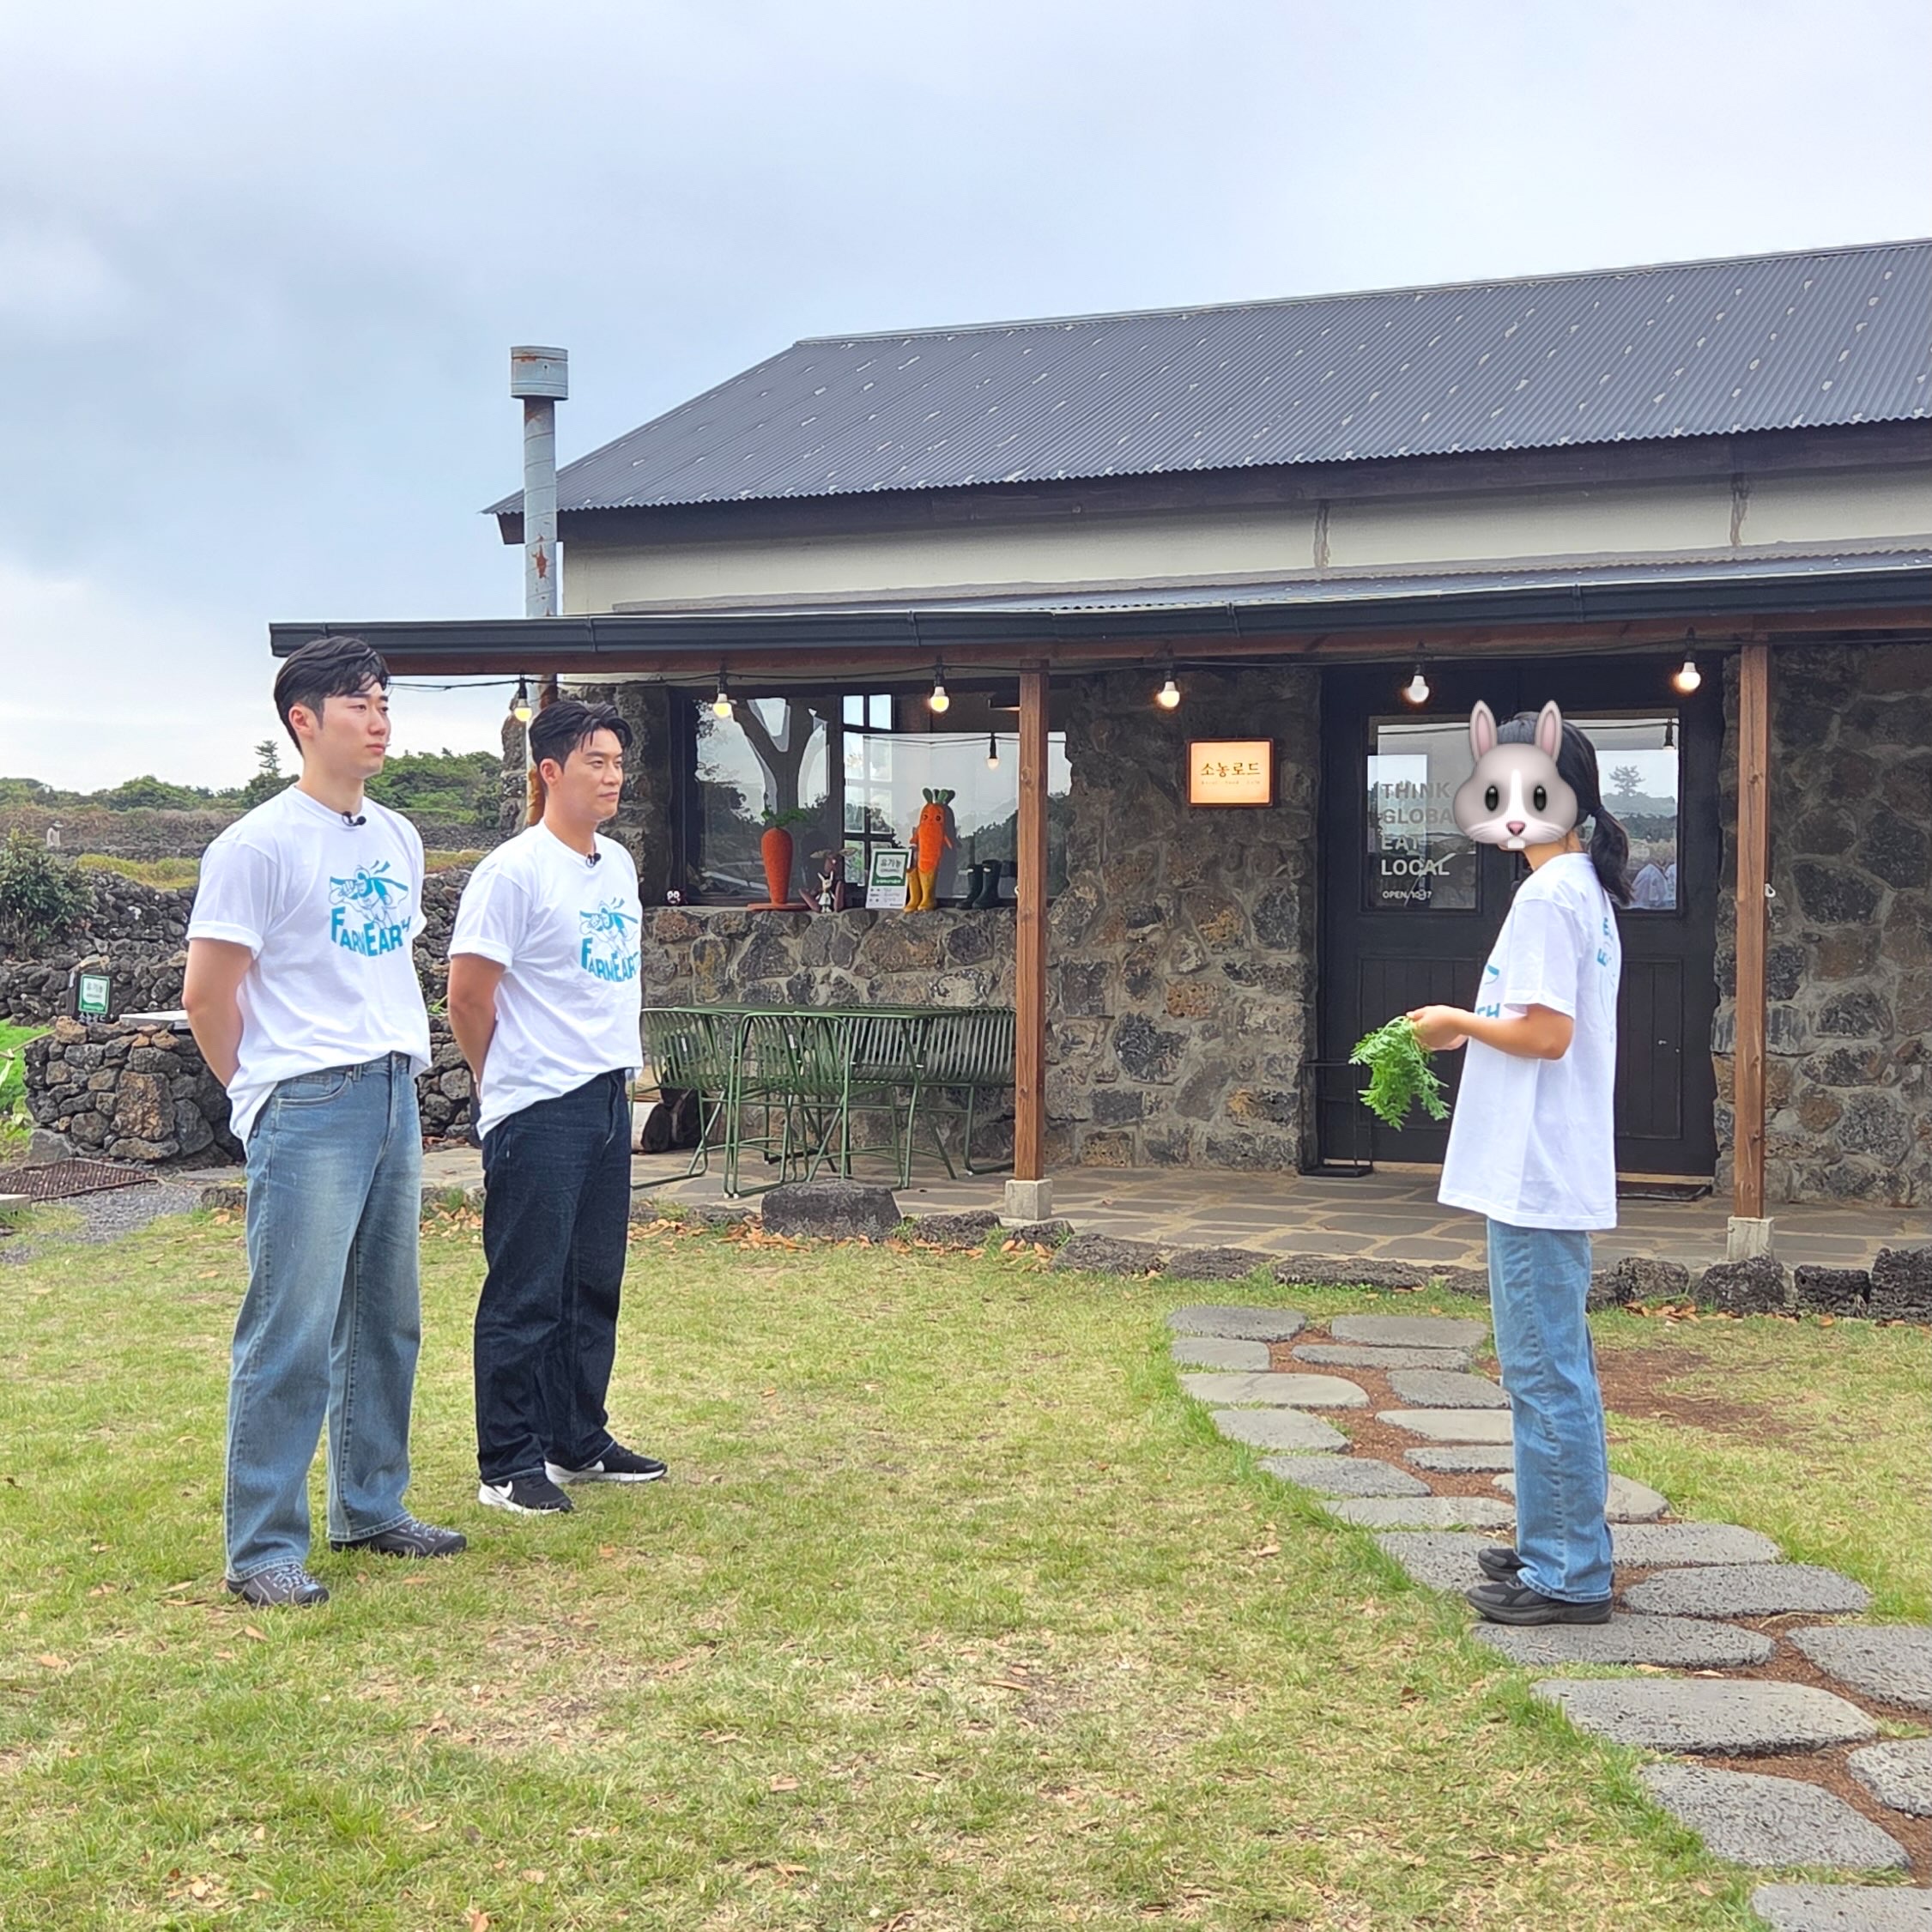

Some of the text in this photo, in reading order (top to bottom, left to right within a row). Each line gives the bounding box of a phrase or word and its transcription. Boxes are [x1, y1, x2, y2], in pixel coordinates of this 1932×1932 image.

[1201, 762, 1261, 778] 소농로드
[1381, 782, 1451, 800] THINK
[1383, 808, 1454, 825] GLOBA
[1381, 834, 1420, 851] EAT
[1381, 859, 1451, 875] LOCAL
[1383, 890, 1408, 899] OPEN
